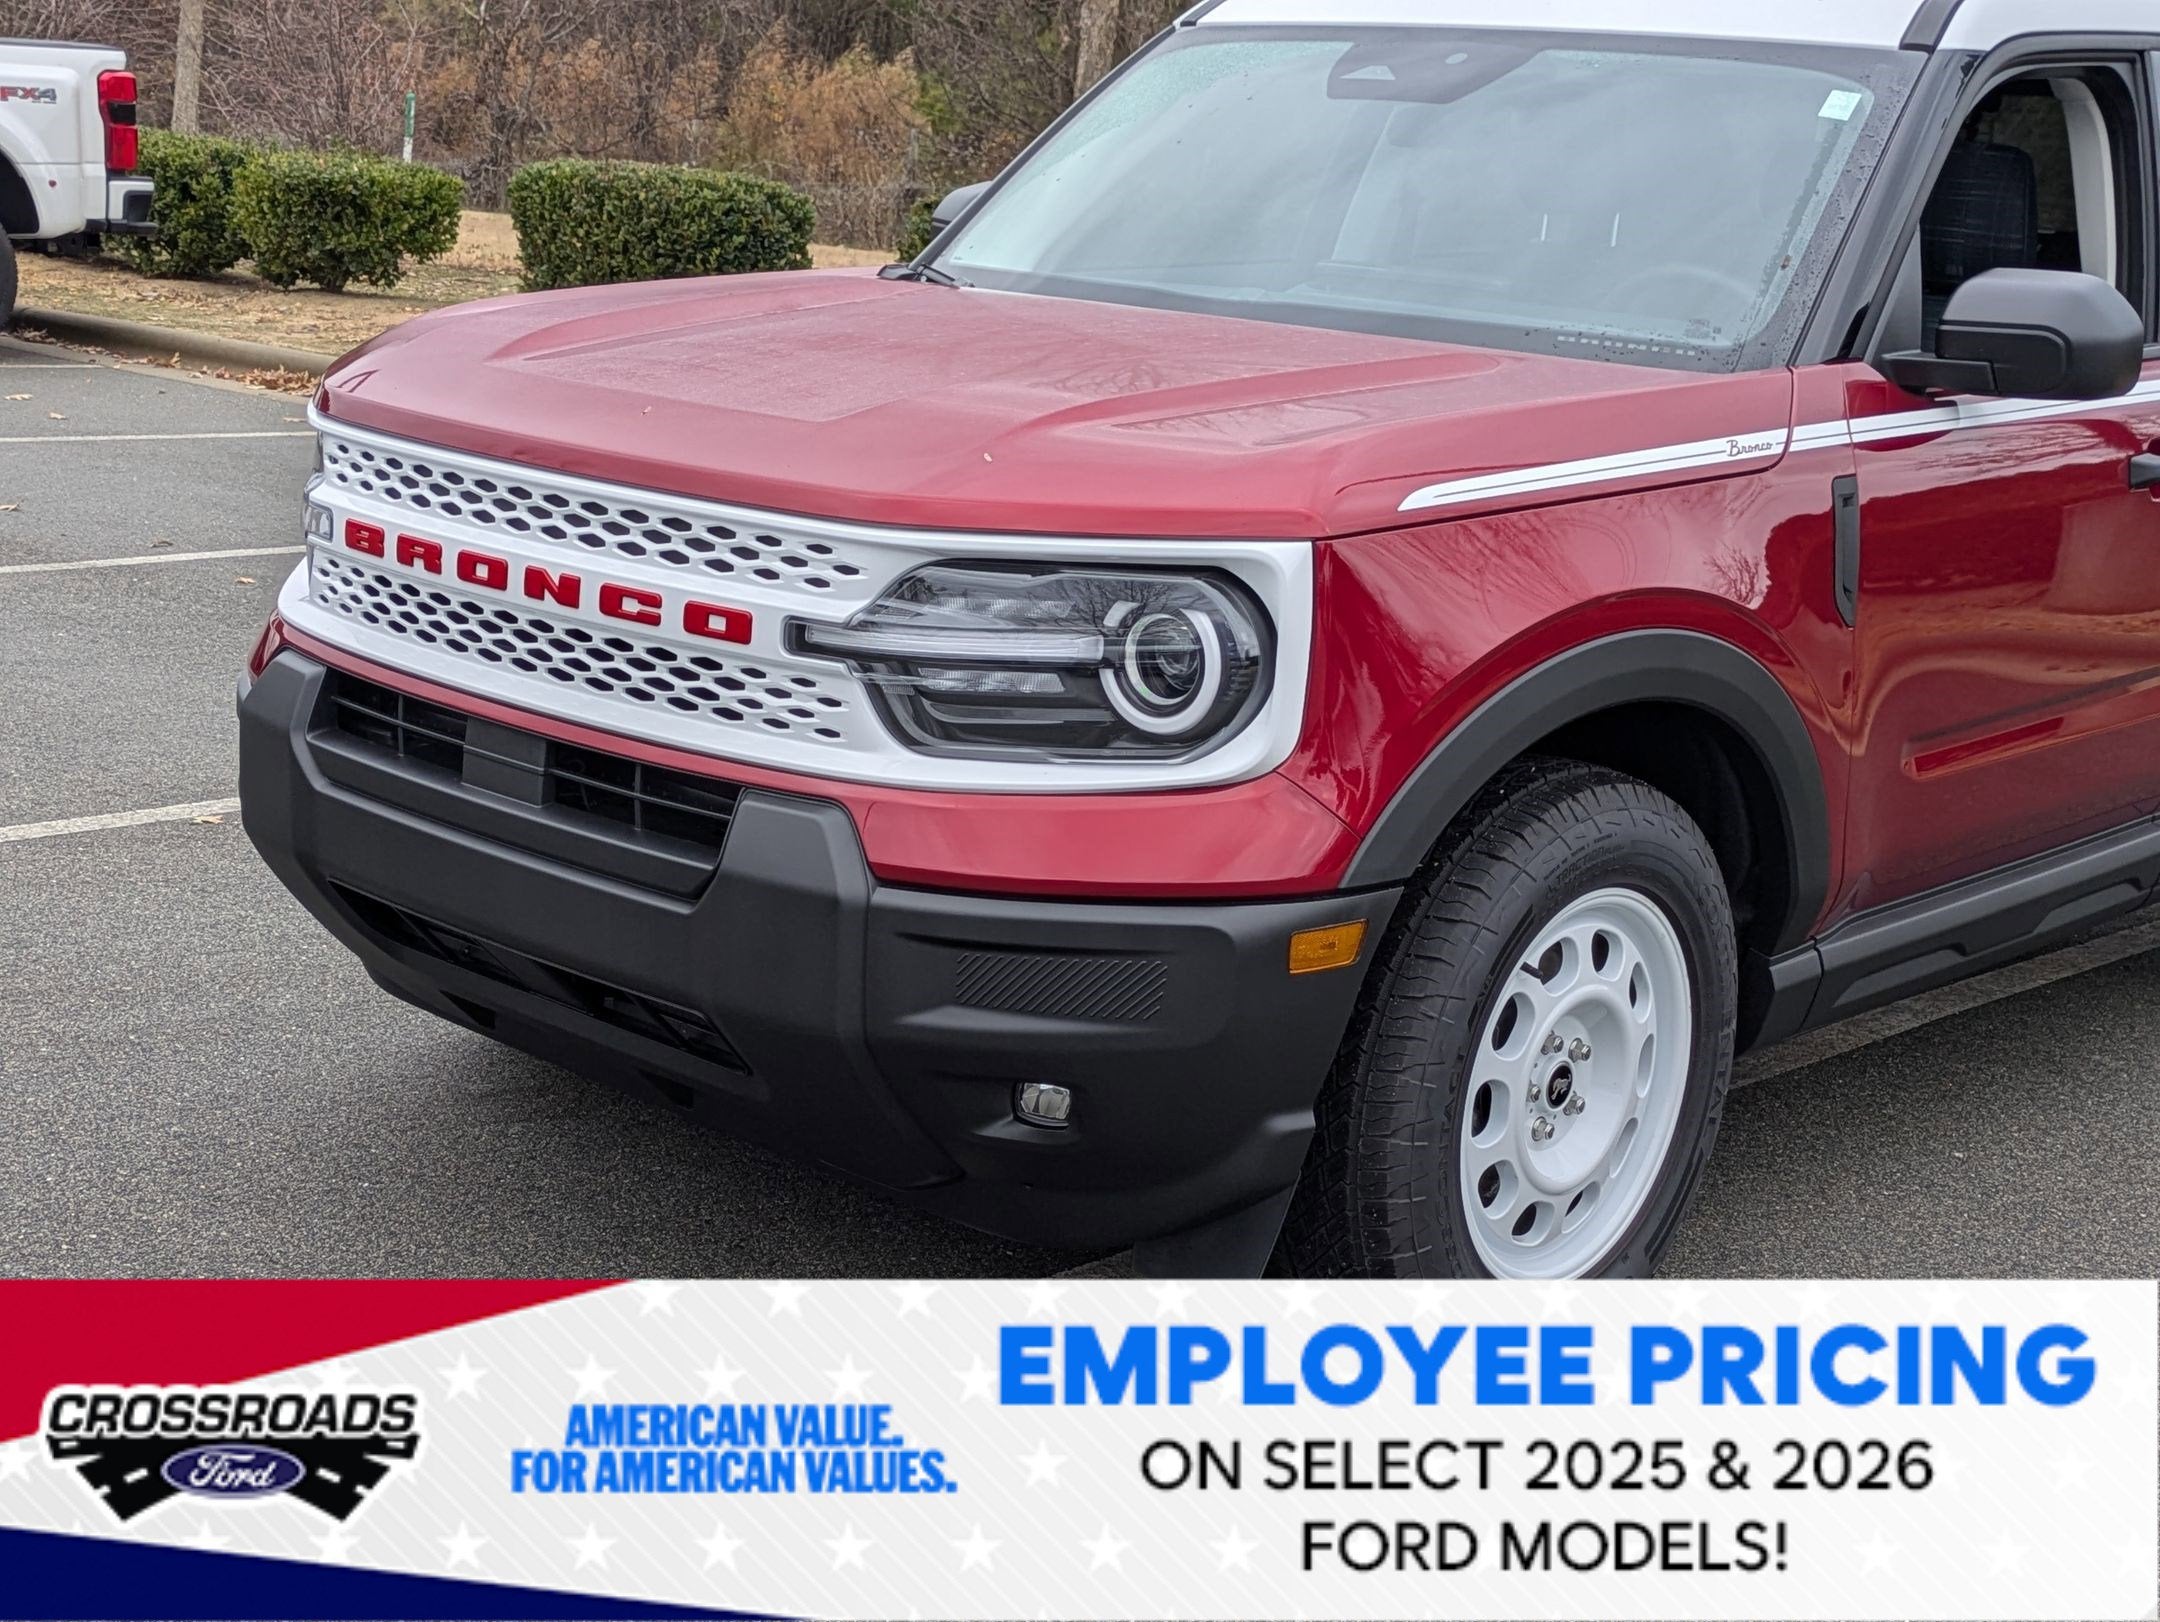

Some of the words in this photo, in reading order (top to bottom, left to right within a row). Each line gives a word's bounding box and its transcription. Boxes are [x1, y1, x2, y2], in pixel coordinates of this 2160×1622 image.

[0, 86, 57, 102] FX4
[1726, 439, 1774, 457] Bronco
[344, 518, 754, 645] BRONCO
